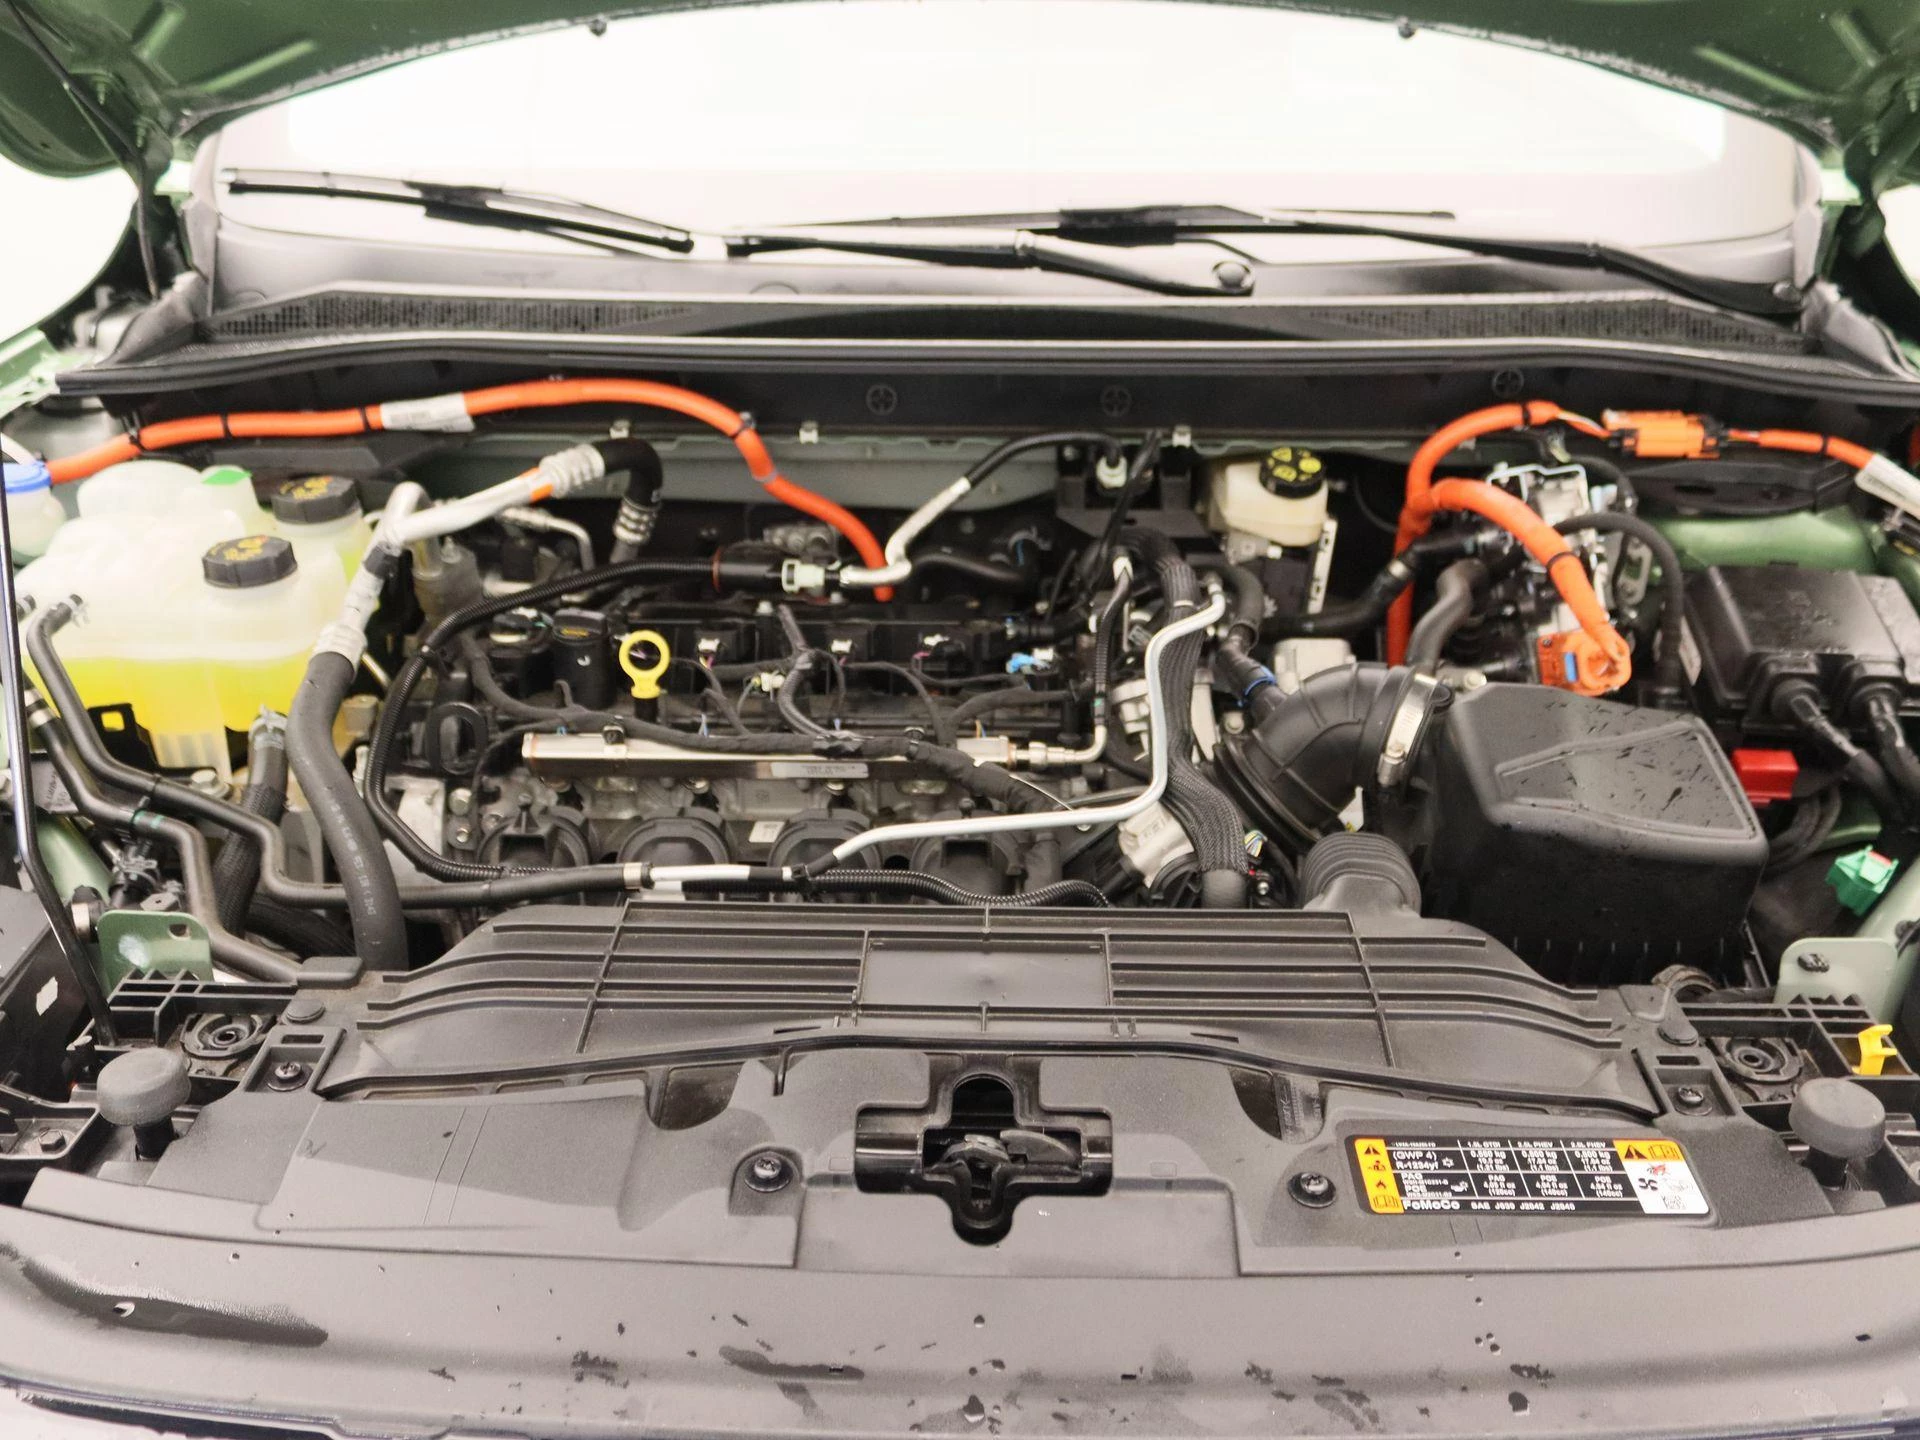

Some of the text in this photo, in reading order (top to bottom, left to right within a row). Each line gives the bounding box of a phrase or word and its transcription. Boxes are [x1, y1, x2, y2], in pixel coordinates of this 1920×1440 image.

[1393, 1151, 1437, 1161] (GWP 4)
[1494, 1150, 1507, 1159] kg
[1545, 1150, 1558, 1159] kg
[1598, 1151, 1611, 1160] kg
[1395, 1161, 1439, 1171] R-1234yf
[1401, 1172, 1423, 1180] PAG
[1402, 1200, 1460, 1210] FoMoCo
